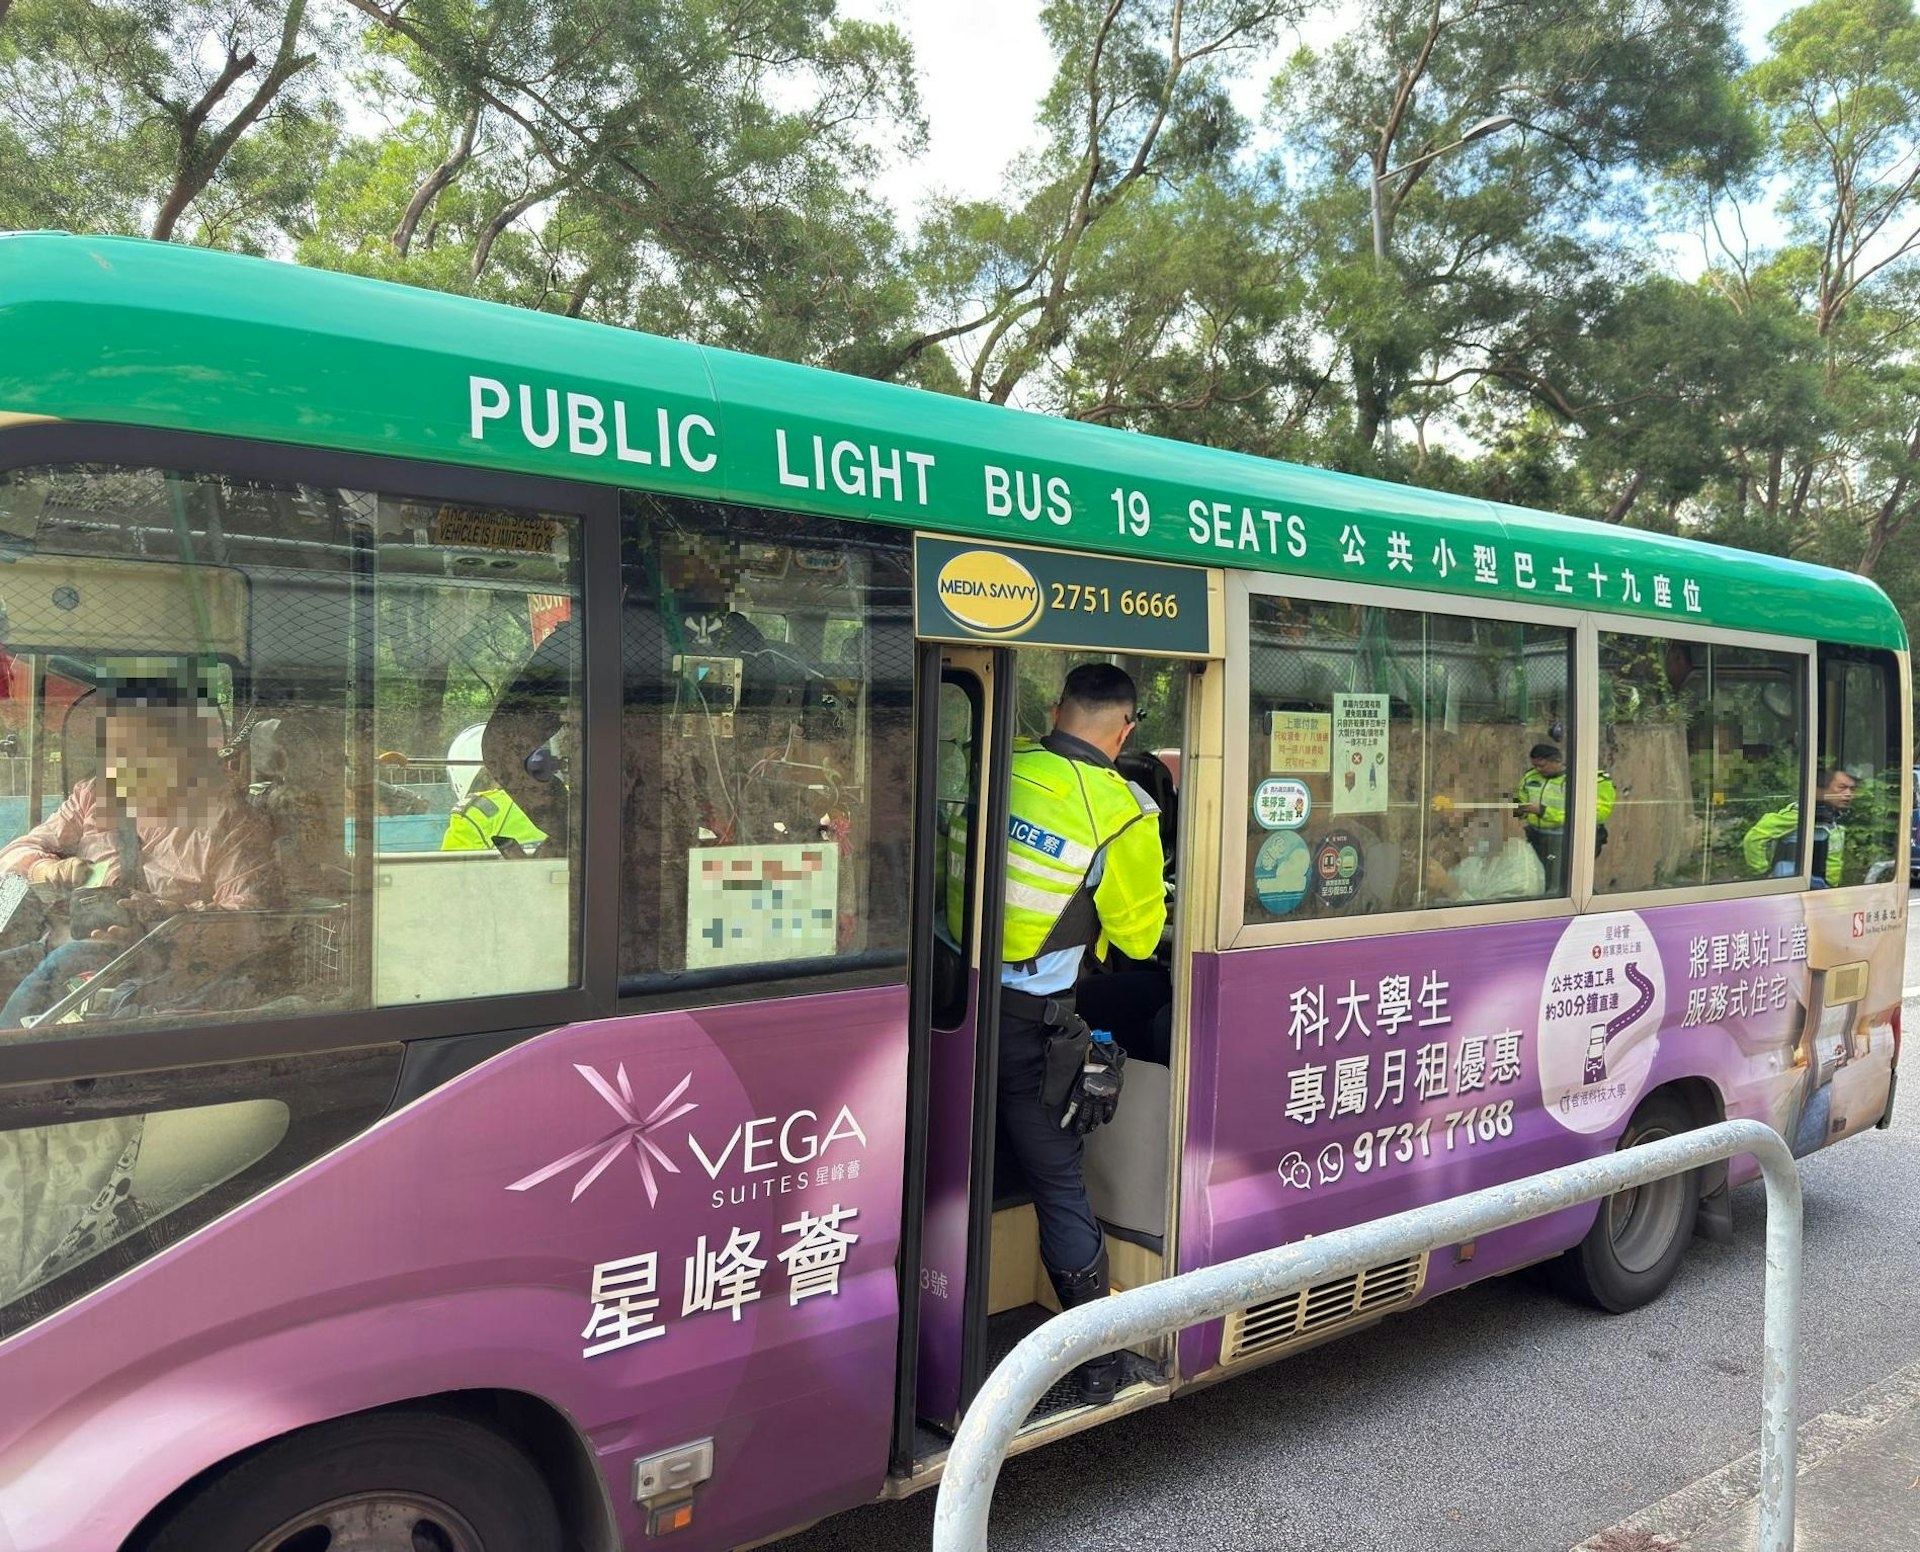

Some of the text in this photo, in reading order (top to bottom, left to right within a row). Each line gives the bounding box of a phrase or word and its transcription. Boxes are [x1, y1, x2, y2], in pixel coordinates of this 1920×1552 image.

[469, 376, 1308, 558] PUBLIC LIGHT BUS 19 SEATS
[440, 521, 479, 542] VEHICLE
[480, 526, 490, 544] IS
[491, 527, 529, 548] LIMITED
[530, 532, 543, 551] TO
[1339, 524, 1703, 613] 公共小型巴士十九座位
[940, 578, 1179, 619] MEDIA SAVVY 2751 6666
[1284, 717, 1319, 730] 上車付款
[1010, 821, 1040, 847] ICE
[1688, 923, 1809, 979] 將軍澳站上蓋
[1545, 992, 1620, 1021] 約30分鐘直達
[1551, 968, 1615, 993] 公共交通工具
[1681, 973, 1788, 1029] 服務式住宅
[1288, 968, 1452, 1051] 科大學生
[1284, 1027, 1524, 1126] 專屬月租優惠
[688, 1104, 867, 1180] VEGA
[1352, 1099, 1515, 1174] 9731 7188
[711, 1159, 861, 1209] SUITES 星峰薈
[580, 1203, 859, 1359] 星峰薈
